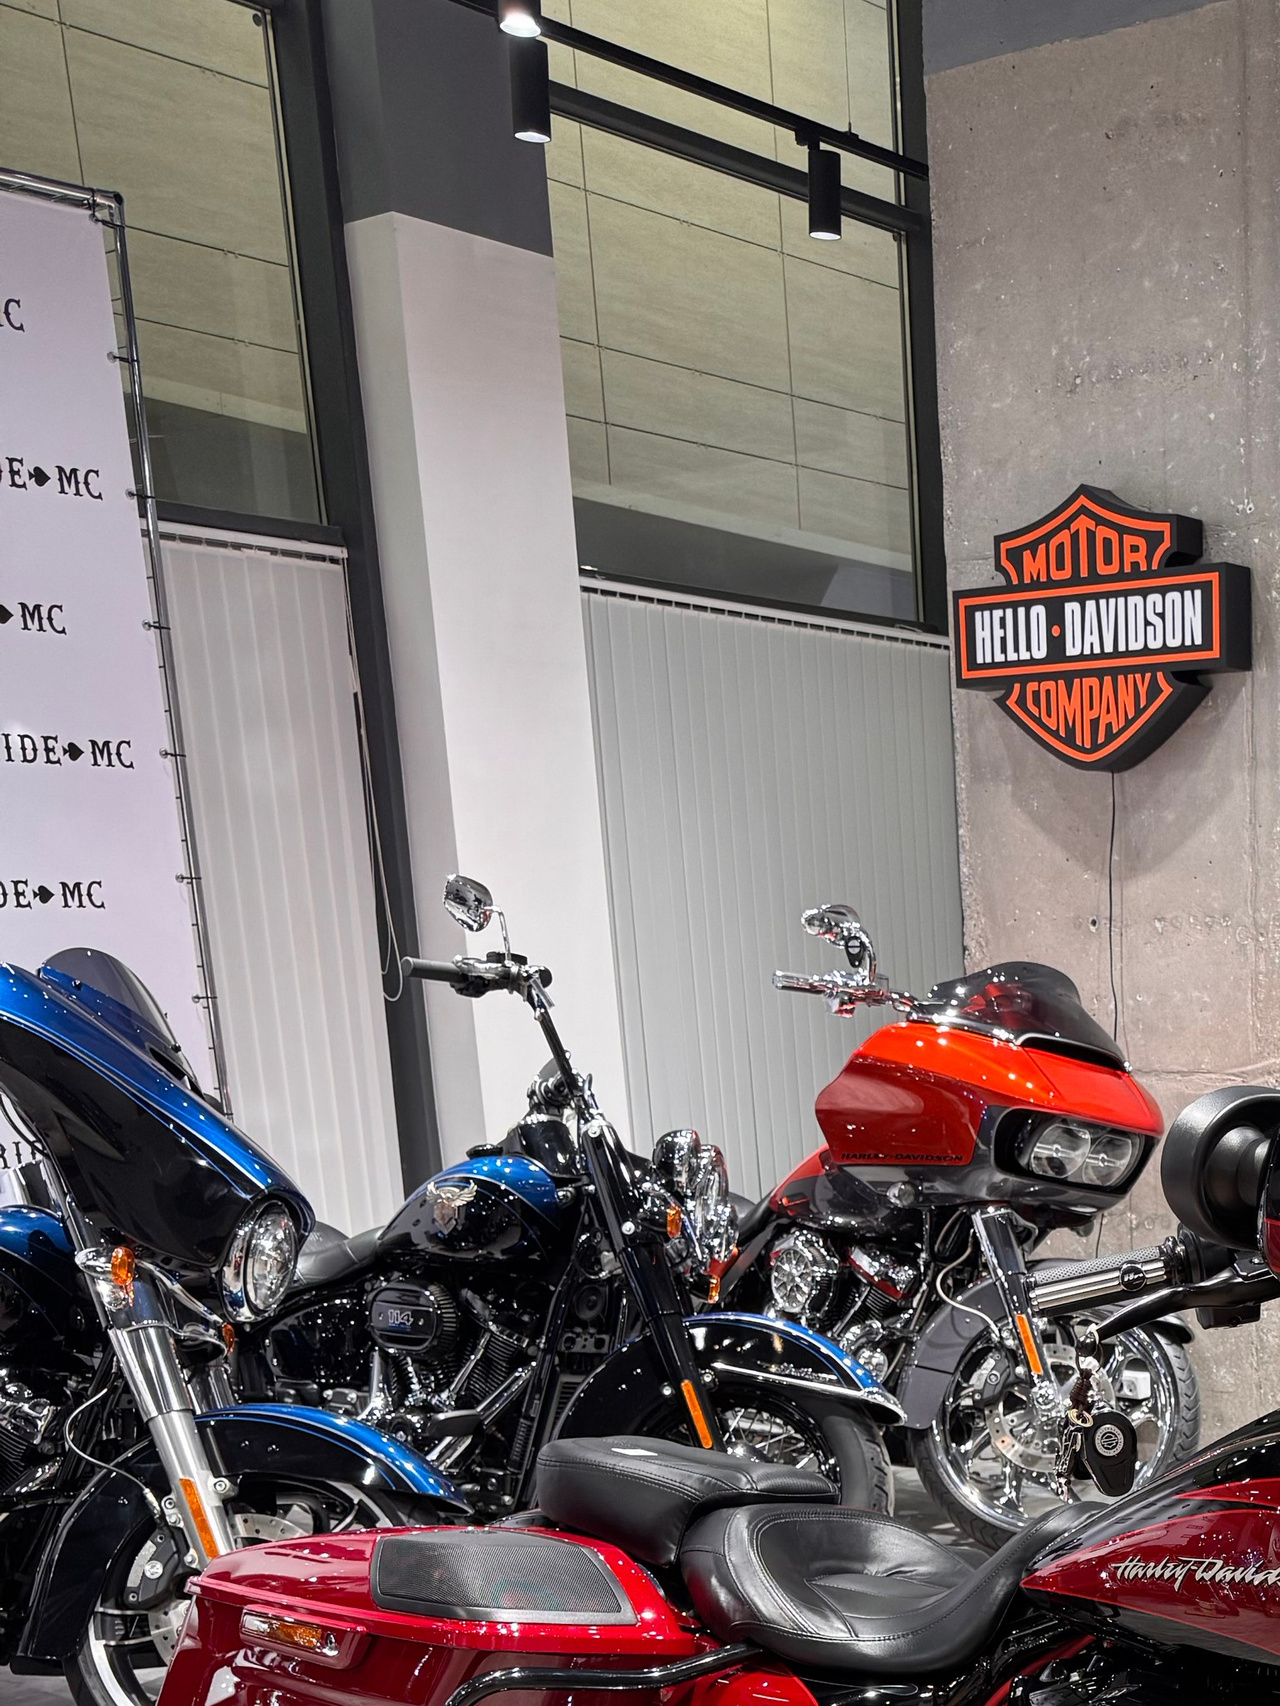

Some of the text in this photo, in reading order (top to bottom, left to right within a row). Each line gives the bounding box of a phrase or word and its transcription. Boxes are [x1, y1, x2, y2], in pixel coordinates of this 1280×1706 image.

[55, 465, 103, 501] MC
[1022, 514, 1148, 584] MOTOR
[17, 601, 67, 635] MC
[974, 589, 1202, 664] HELLO DAVIDSON
[1026, 672, 1151, 748] COMPANY
[88, 739, 135, 770] MC
[58, 880, 106, 909] MC
[387, 1309, 414, 1326] 114
